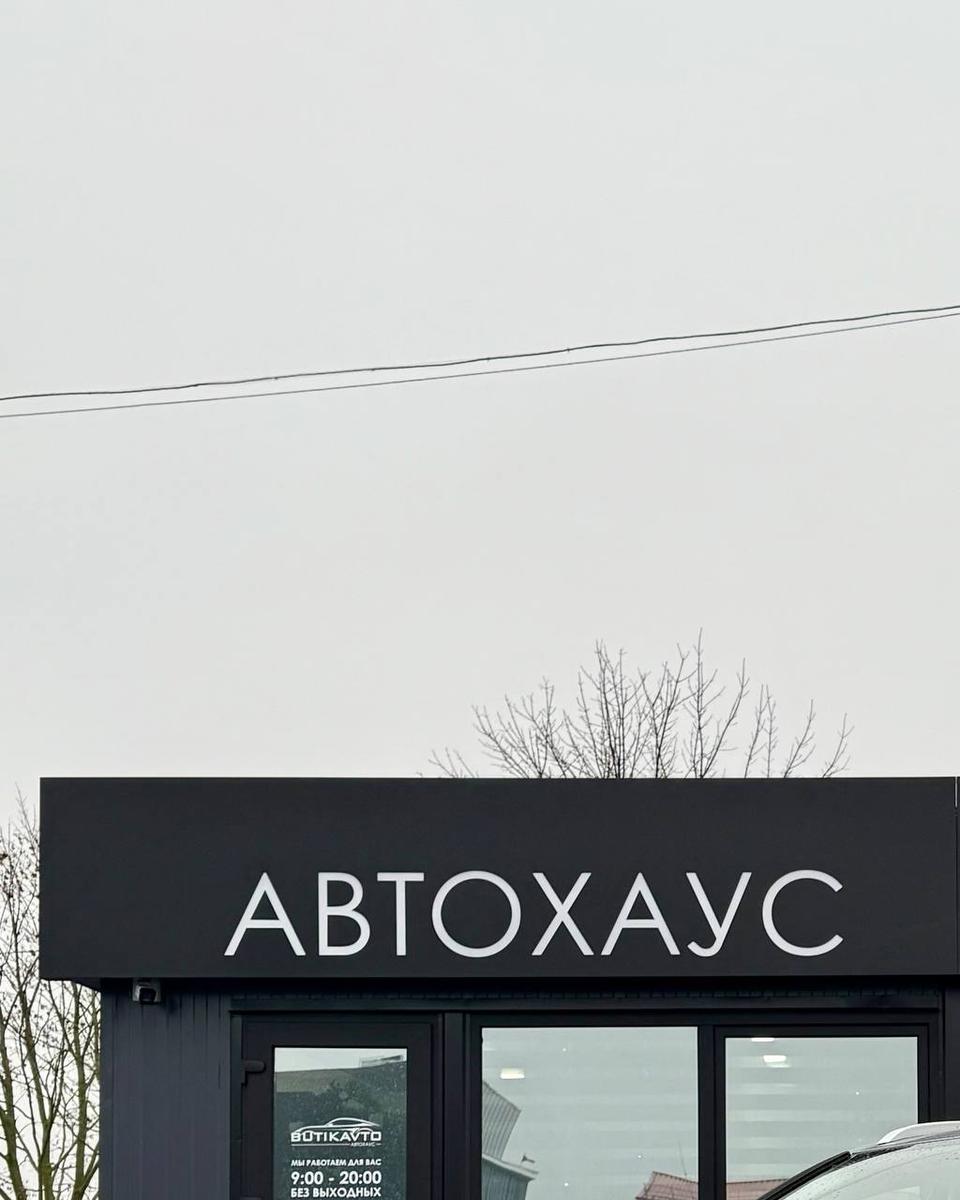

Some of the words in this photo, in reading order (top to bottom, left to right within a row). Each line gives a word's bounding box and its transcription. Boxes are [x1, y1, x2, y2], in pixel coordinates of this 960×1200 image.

[223, 870, 844, 958] АВТОХАУС
[290, 1131, 382, 1142] BUTIKAVTO
[291, 1159, 305, 1167] МЫ
[306, 1159, 347, 1167] РАБОТАЕМ
[348, 1159, 364, 1167] ДЛЯ
[365, 1158, 382, 1166] ВАС
[291, 1171, 324, 1185] 9:00
[339, 1170, 382, 1185] 20:00
[290, 1187, 310, 1198] БЕЗ
[312, 1187, 382, 1198] ВЫХОДНЫХ
